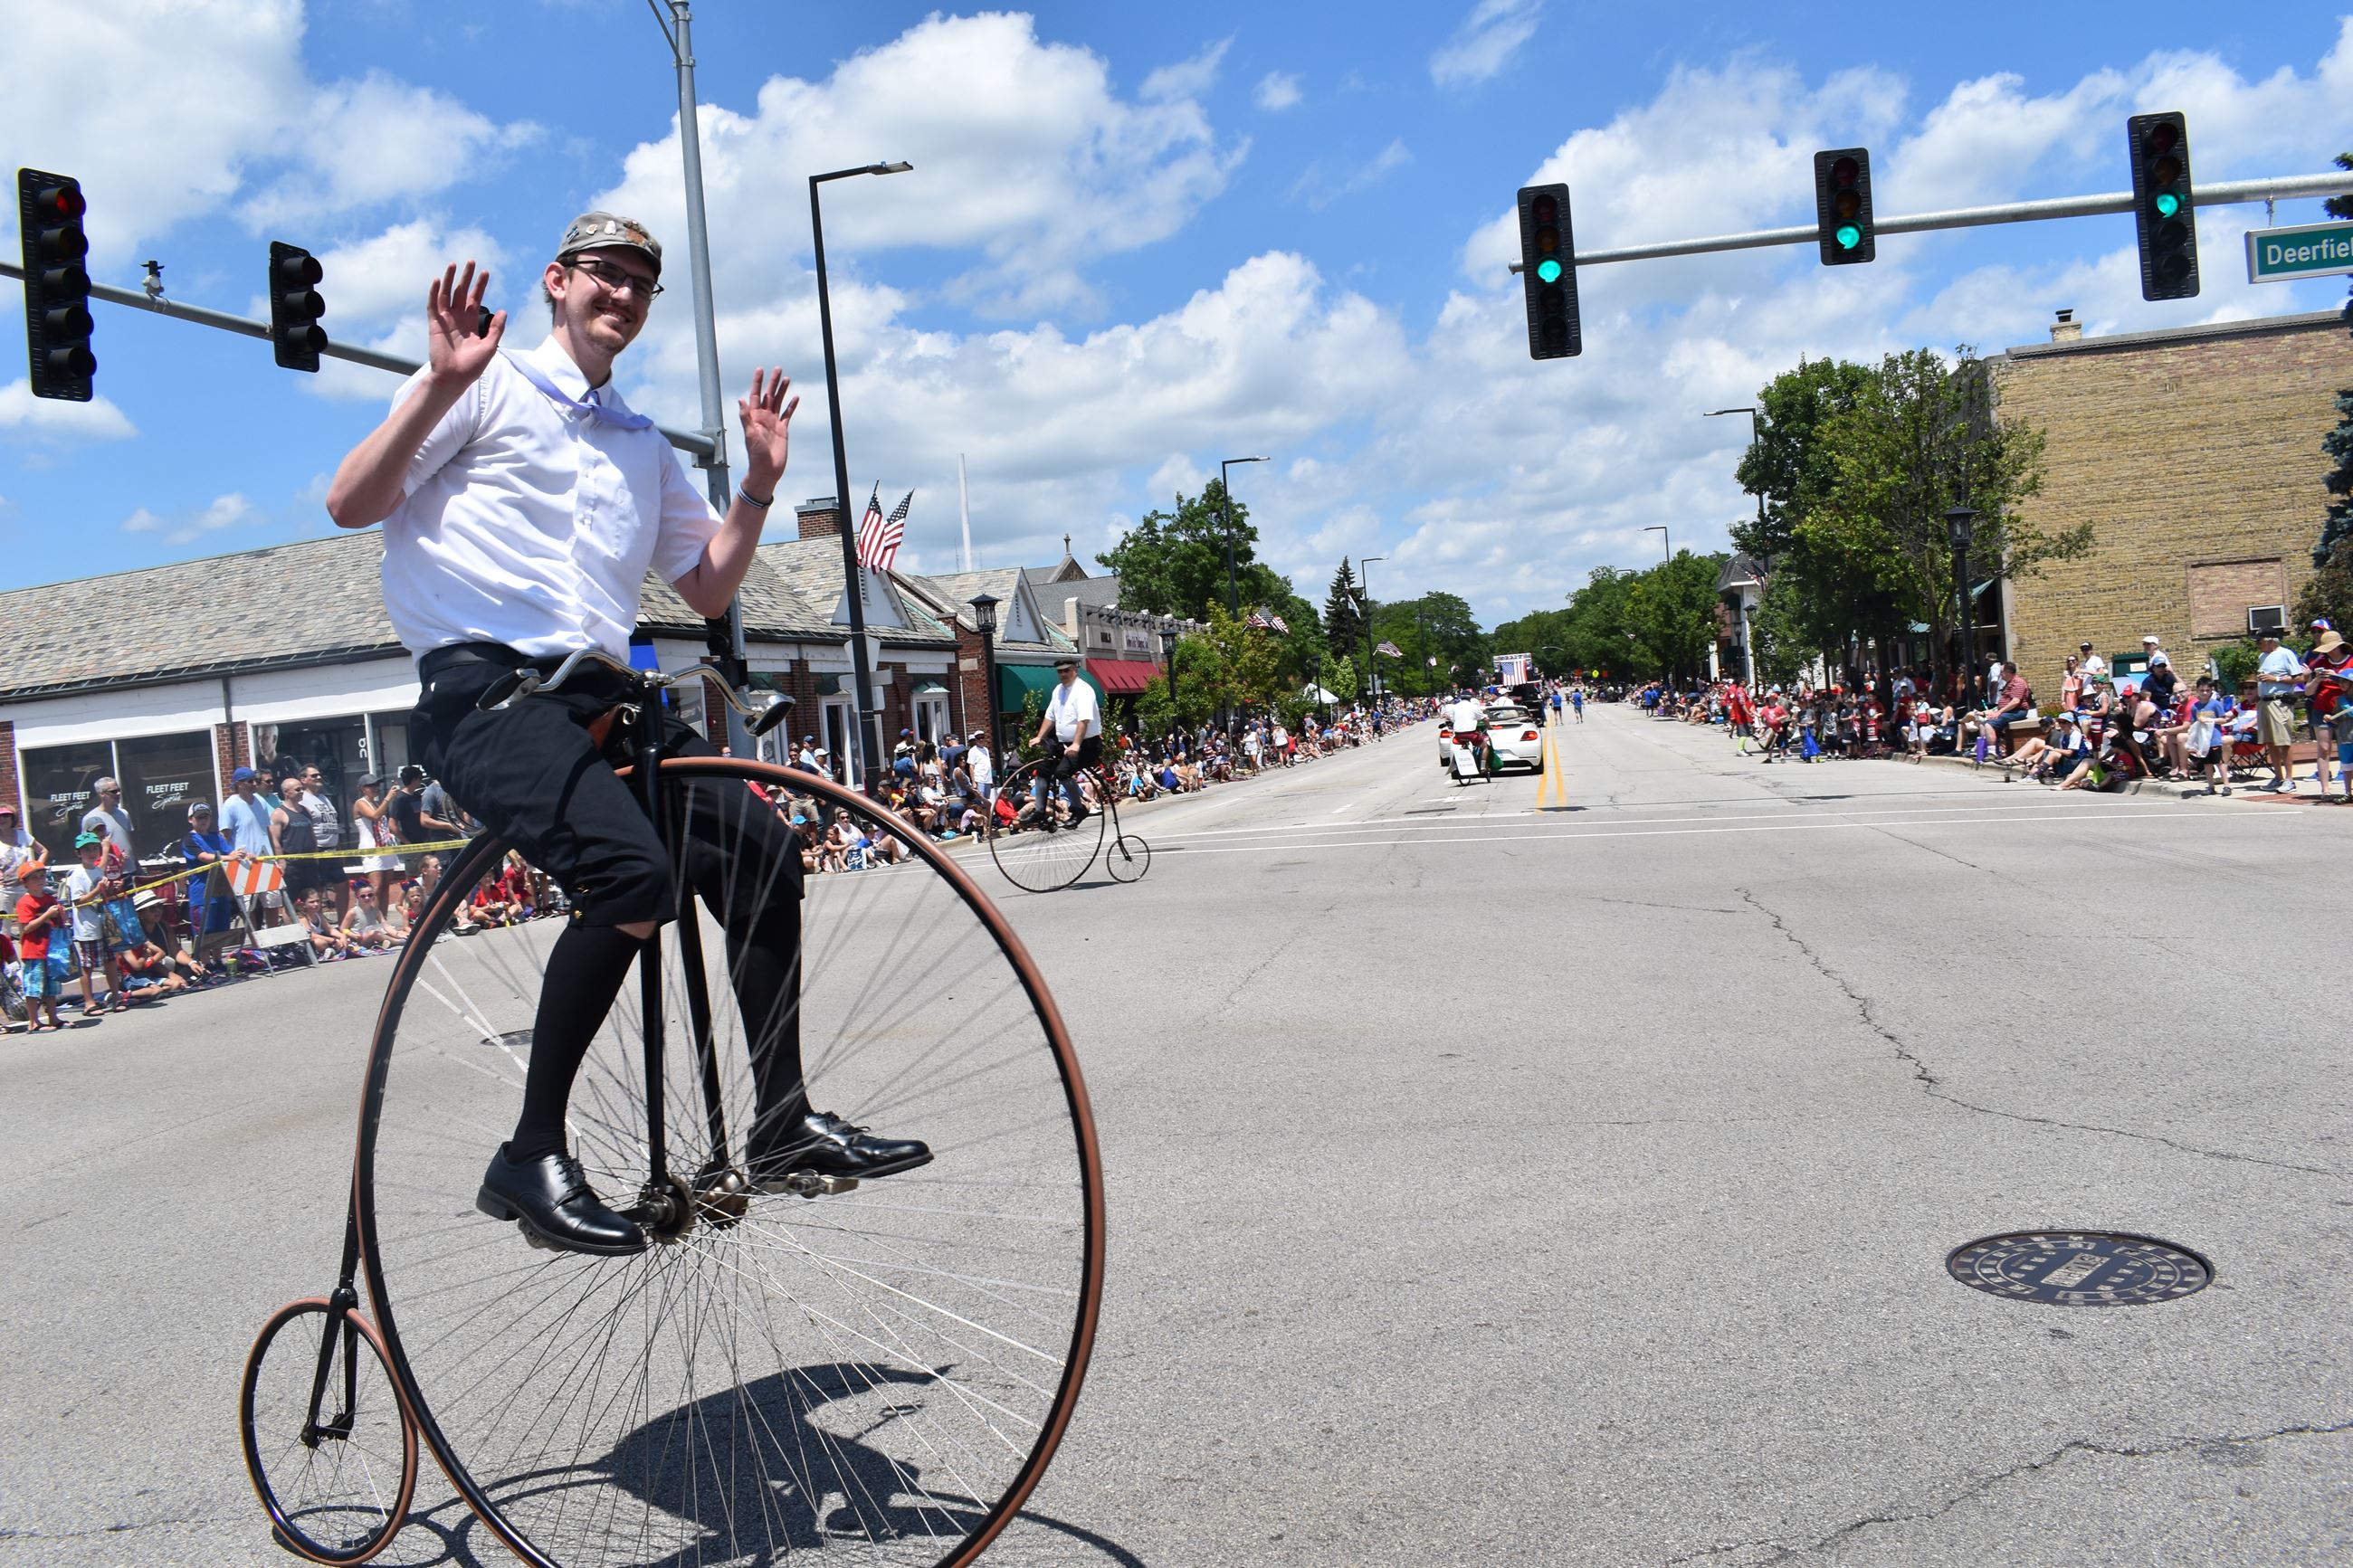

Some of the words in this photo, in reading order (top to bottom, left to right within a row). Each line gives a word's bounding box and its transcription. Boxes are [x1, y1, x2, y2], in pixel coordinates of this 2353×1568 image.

[146, 784, 169, 794] FLEET
[169, 782, 190, 792] FEET
[51, 793, 72, 803] FLEET
[72, 791, 90, 801] FEET
[151, 792, 185, 810] Sports
[56, 801, 86, 818] Sports
